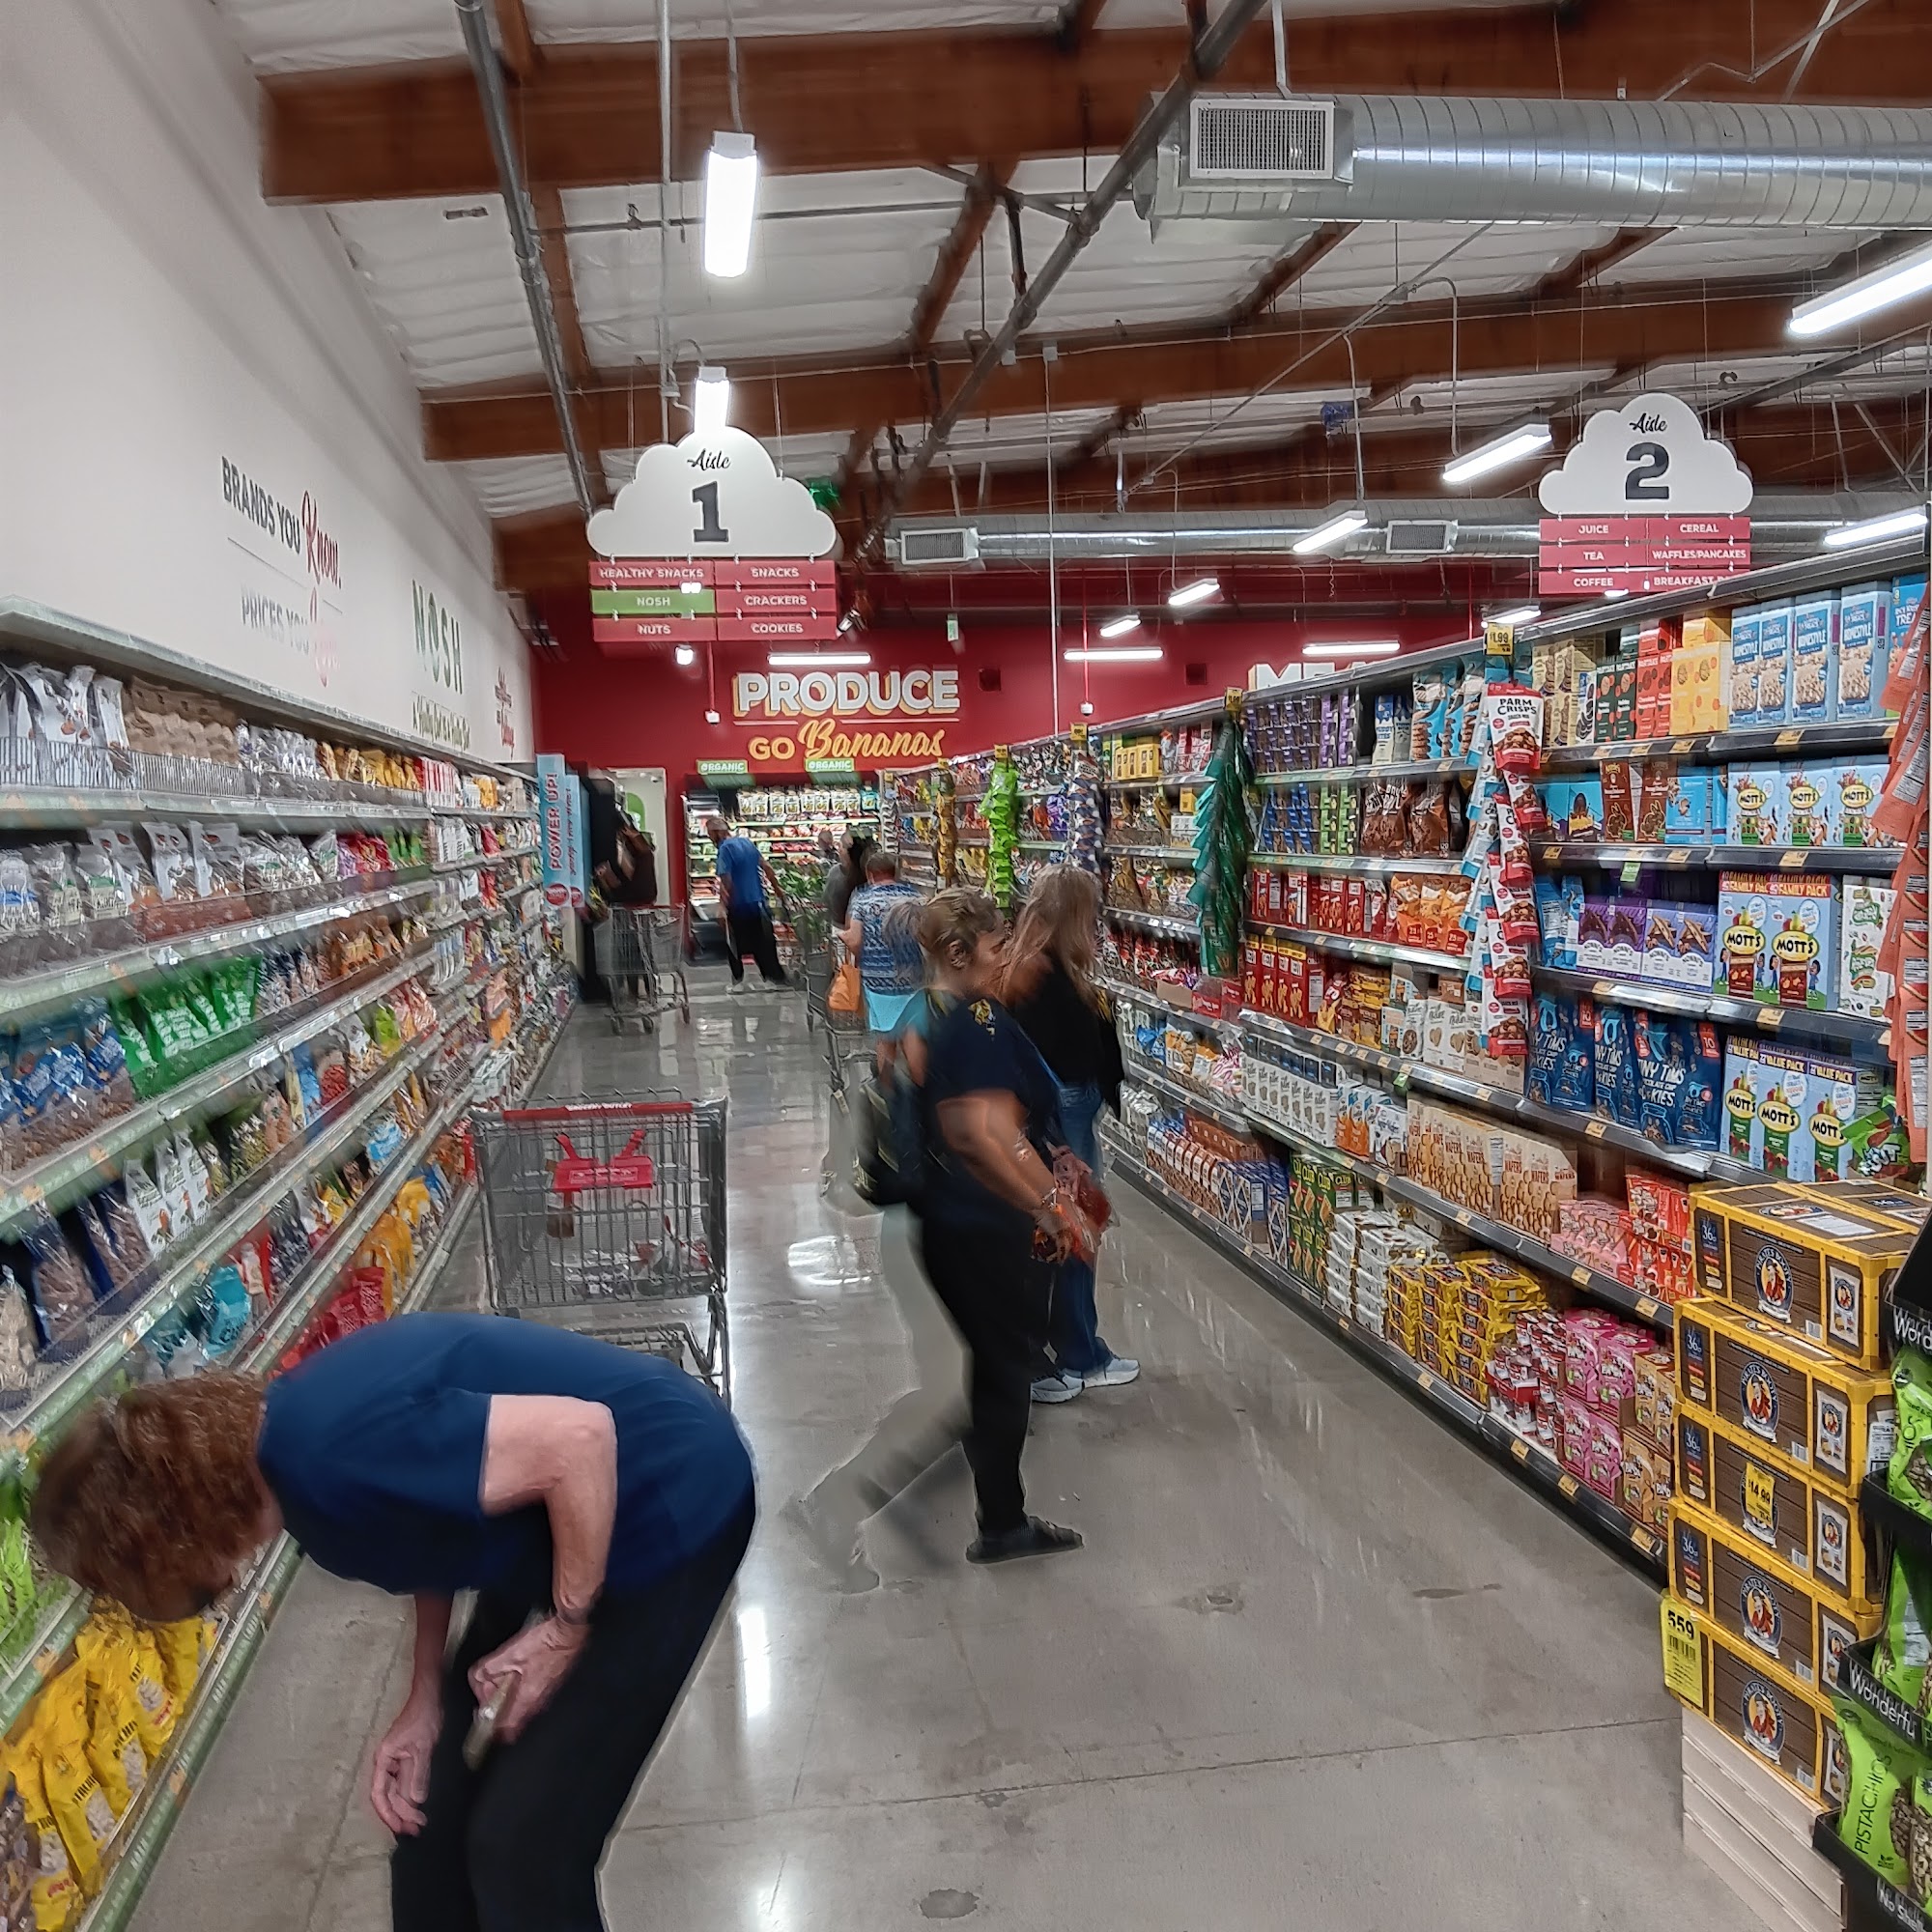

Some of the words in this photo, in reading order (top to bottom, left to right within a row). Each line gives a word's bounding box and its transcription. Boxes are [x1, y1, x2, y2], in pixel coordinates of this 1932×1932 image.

[1629, 412, 1668, 434] Aisle
[687, 448, 731, 471] Aisle
[1626, 441, 1670, 499] 2
[221, 455, 275, 537] BRANDS
[276, 501, 300, 555] YOU
[692, 480, 729, 543] 1
[1578, 525, 1608, 534] JUICE
[1680, 523, 1719, 532] CEREAL
[1583, 551, 1605, 561] TEA
[1652, 549, 1747, 559] WAFFLES/PANCAKES
[599, 568, 654, 580] HEALTHY
[657, 568, 704, 579] SNACKS
[751, 567, 800, 578] SNACKS
[1573, 577, 1614, 586] COFFEE
[1653, 576, 1715, 586] BREAKFAST
[637, 596, 670, 607] NOSH
[744, 595, 808, 607] CRACKERS
[638, 624, 671, 636] NUTS
[751, 623, 804, 635] COOKIES
[412, 579, 463, 695] NOSH
[733, 669, 960, 717] PRODUCE
[1499, 697, 1532, 706] PARM
[1497, 705, 1537, 715] CRISPS
[748, 736, 796, 760] GO
[797, 718, 946, 759] Bananas
[700, 761, 745, 773] ORGANIC
[808, 759, 852, 770] ORGANIC
[544, 773, 560, 804] UP!
[547, 806, 563, 871] POWER
[1806, 885, 1828, 896] PACK
[1703, 1037, 1716, 1049] 10
[1702, 1225, 1714, 1240] 36
[1687, 1334, 1699, 1351] 36
[1686, 1432, 1697, 1449] 36
[1682, 1536, 1694, 1554] 36
[1667, 1609, 1694, 1640] 559
